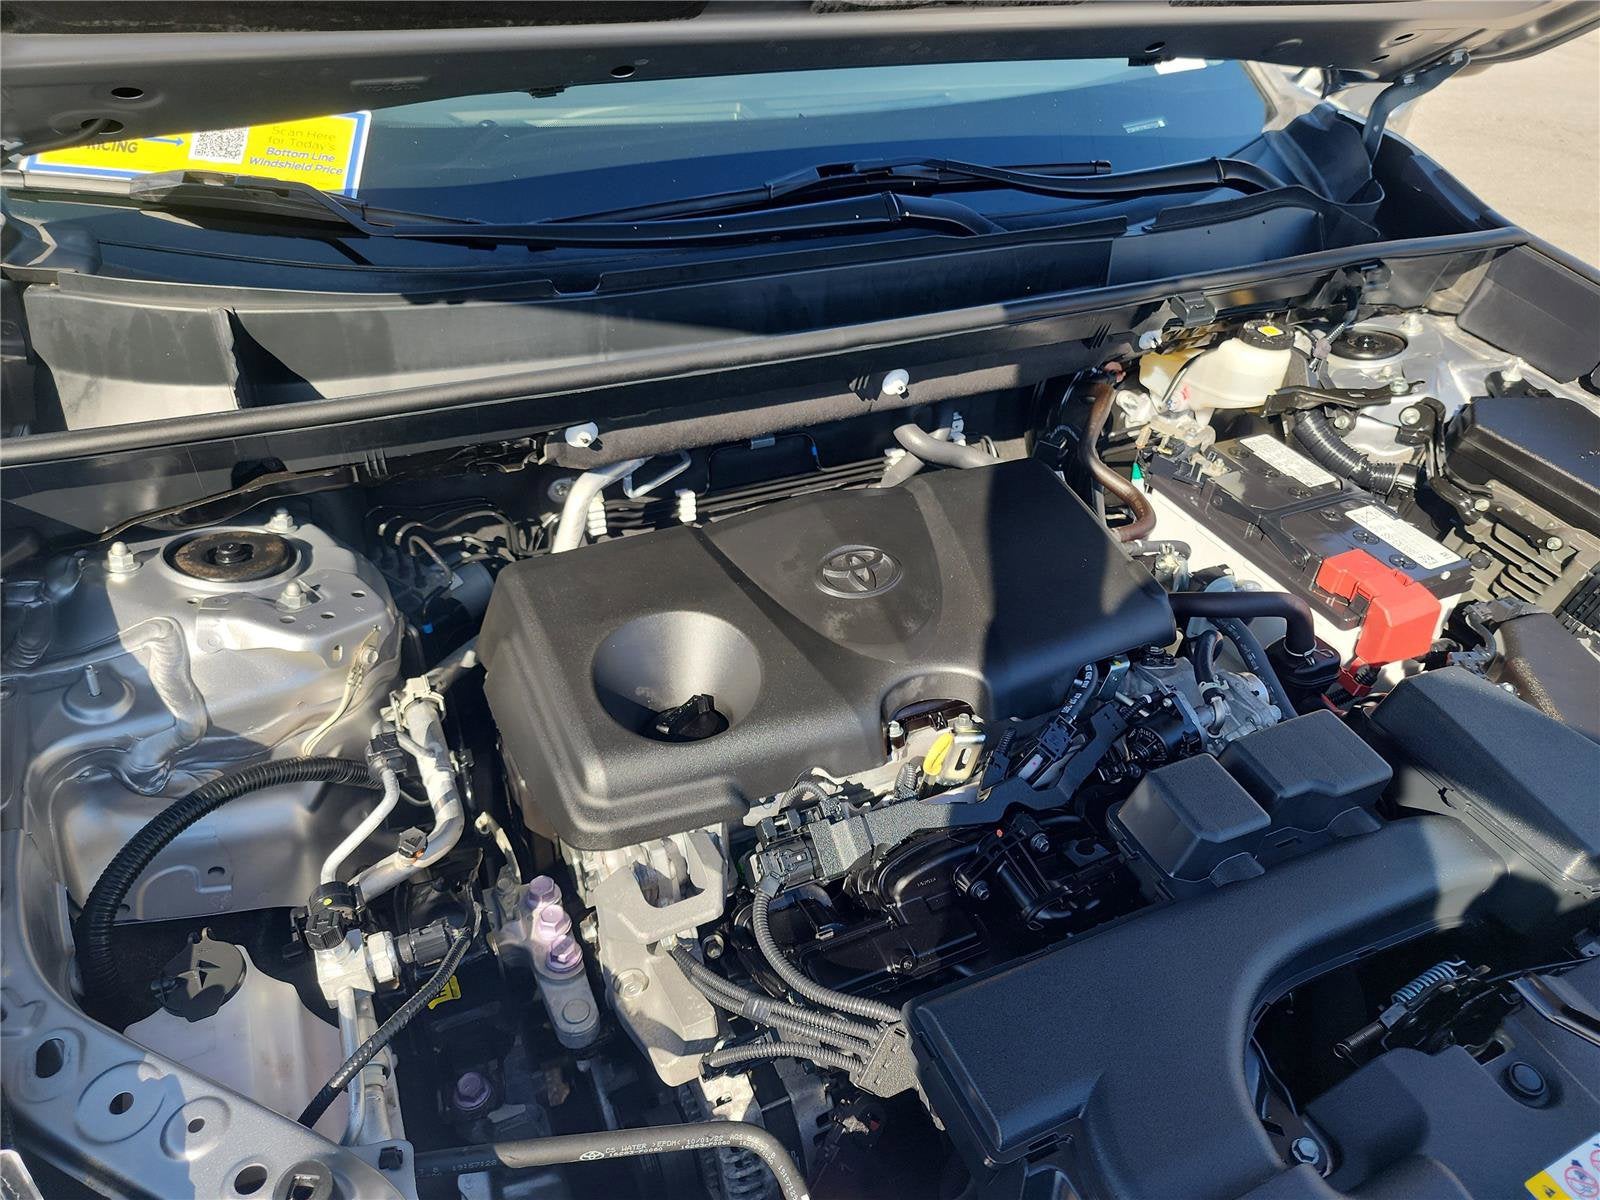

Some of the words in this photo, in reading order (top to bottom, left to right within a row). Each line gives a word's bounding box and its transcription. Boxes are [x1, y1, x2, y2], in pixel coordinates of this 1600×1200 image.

[272, 126, 303, 137] Scan
[306, 131, 336, 142] Here
[86, 141, 138, 153] ICING
[266, 147, 309, 159] Bottom
[311, 151, 335, 162] Line
[249, 156, 312, 172] Windshield
[314, 163, 343, 175] Price
[621, 1142, 647, 1152] WATER
